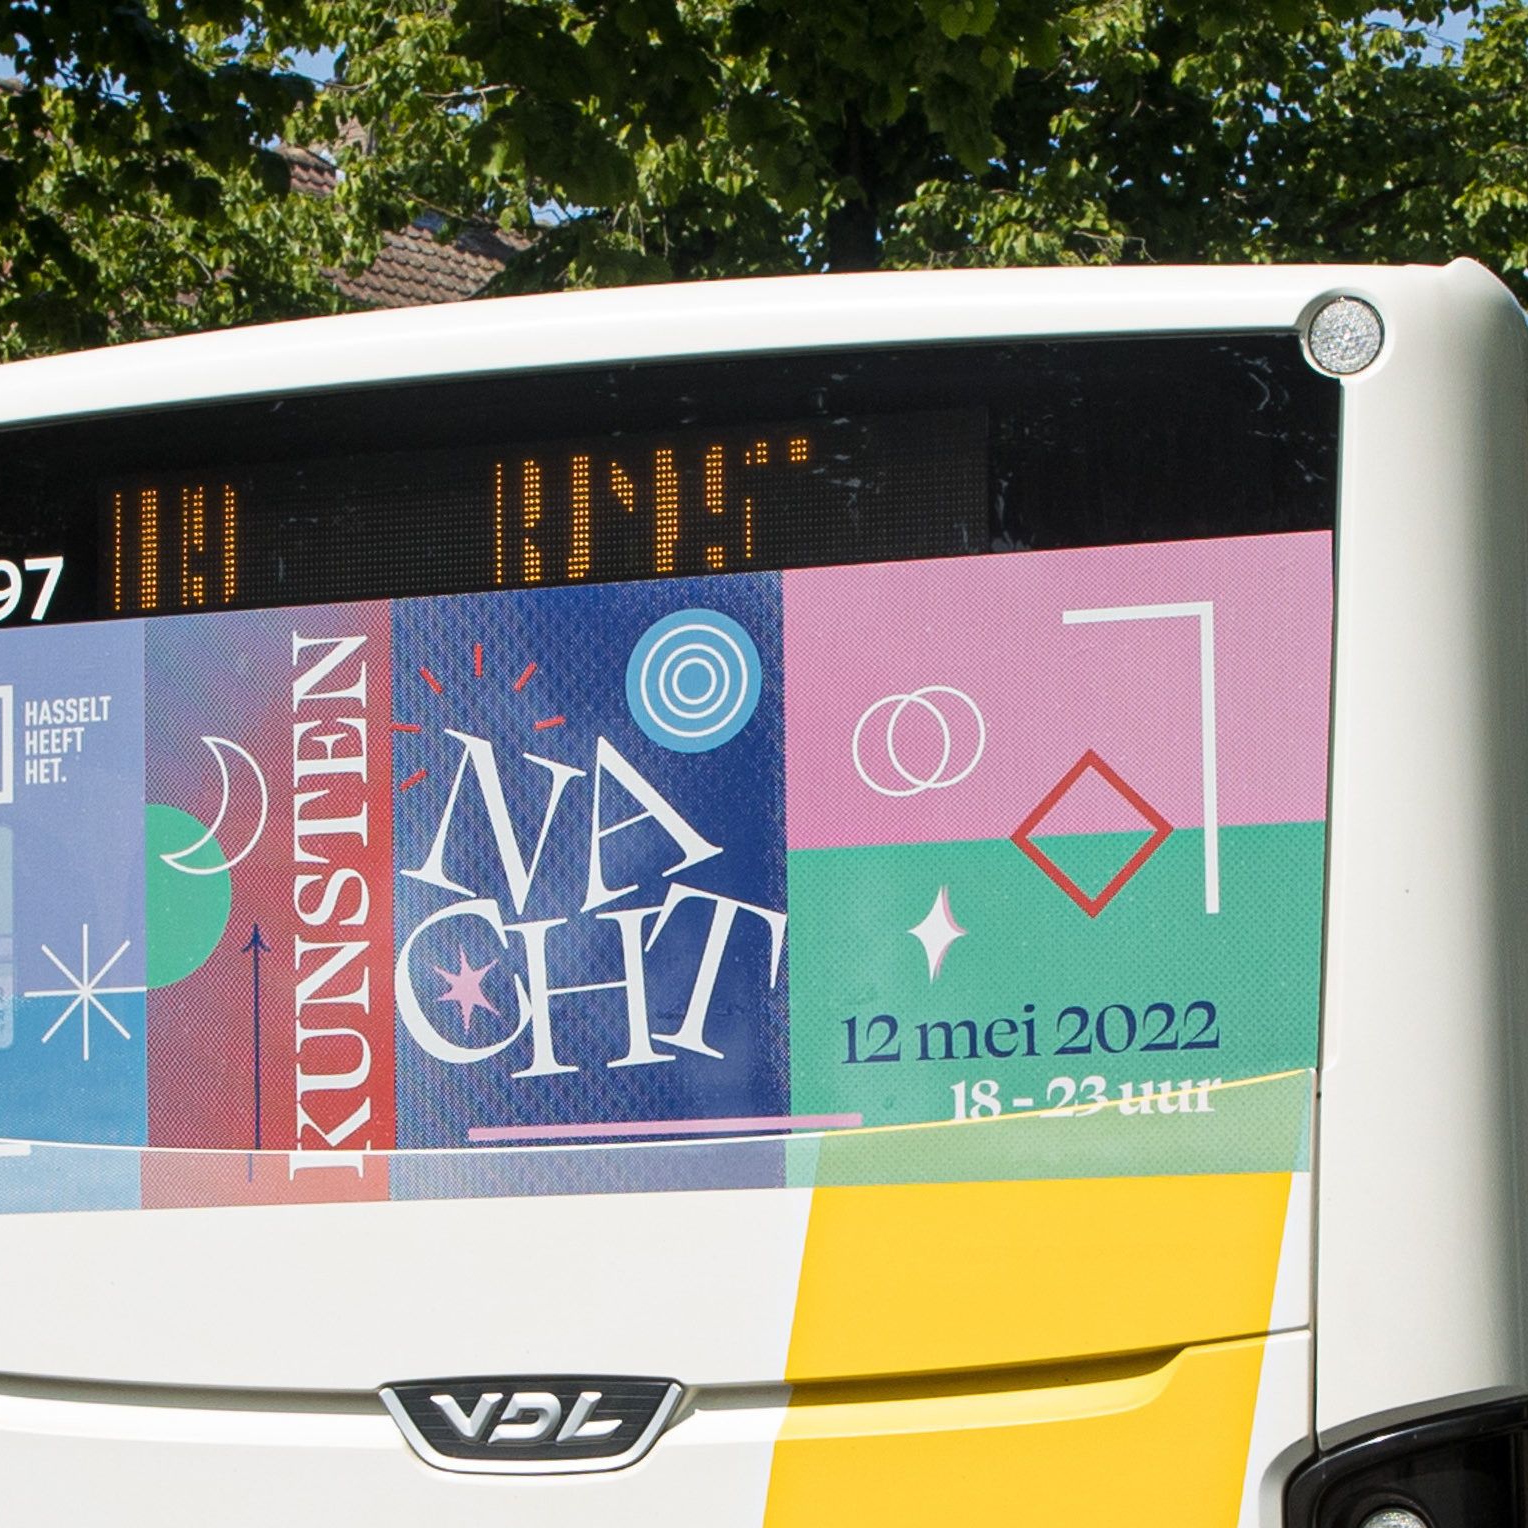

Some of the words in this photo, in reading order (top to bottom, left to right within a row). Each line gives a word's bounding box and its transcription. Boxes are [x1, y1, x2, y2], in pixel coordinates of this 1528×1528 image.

[25, 696, 112, 726] HASSELT
[25, 727, 85, 755] HEEFT
[25, 757, 67, 784] HET.
[289, 631, 372, 1180] KUNSTEN
[840, 1013, 901, 1065] 12
[915, 1003, 1041, 1061] mei
[1053, 999, 1221, 1056] 2022
[949, 1078, 1003, 1122] 18
[1038, 1074, 1108, 1118] 23
[1117, 1076, 1222, 1116] uur
[430, 1391, 622, 1446] VDL
